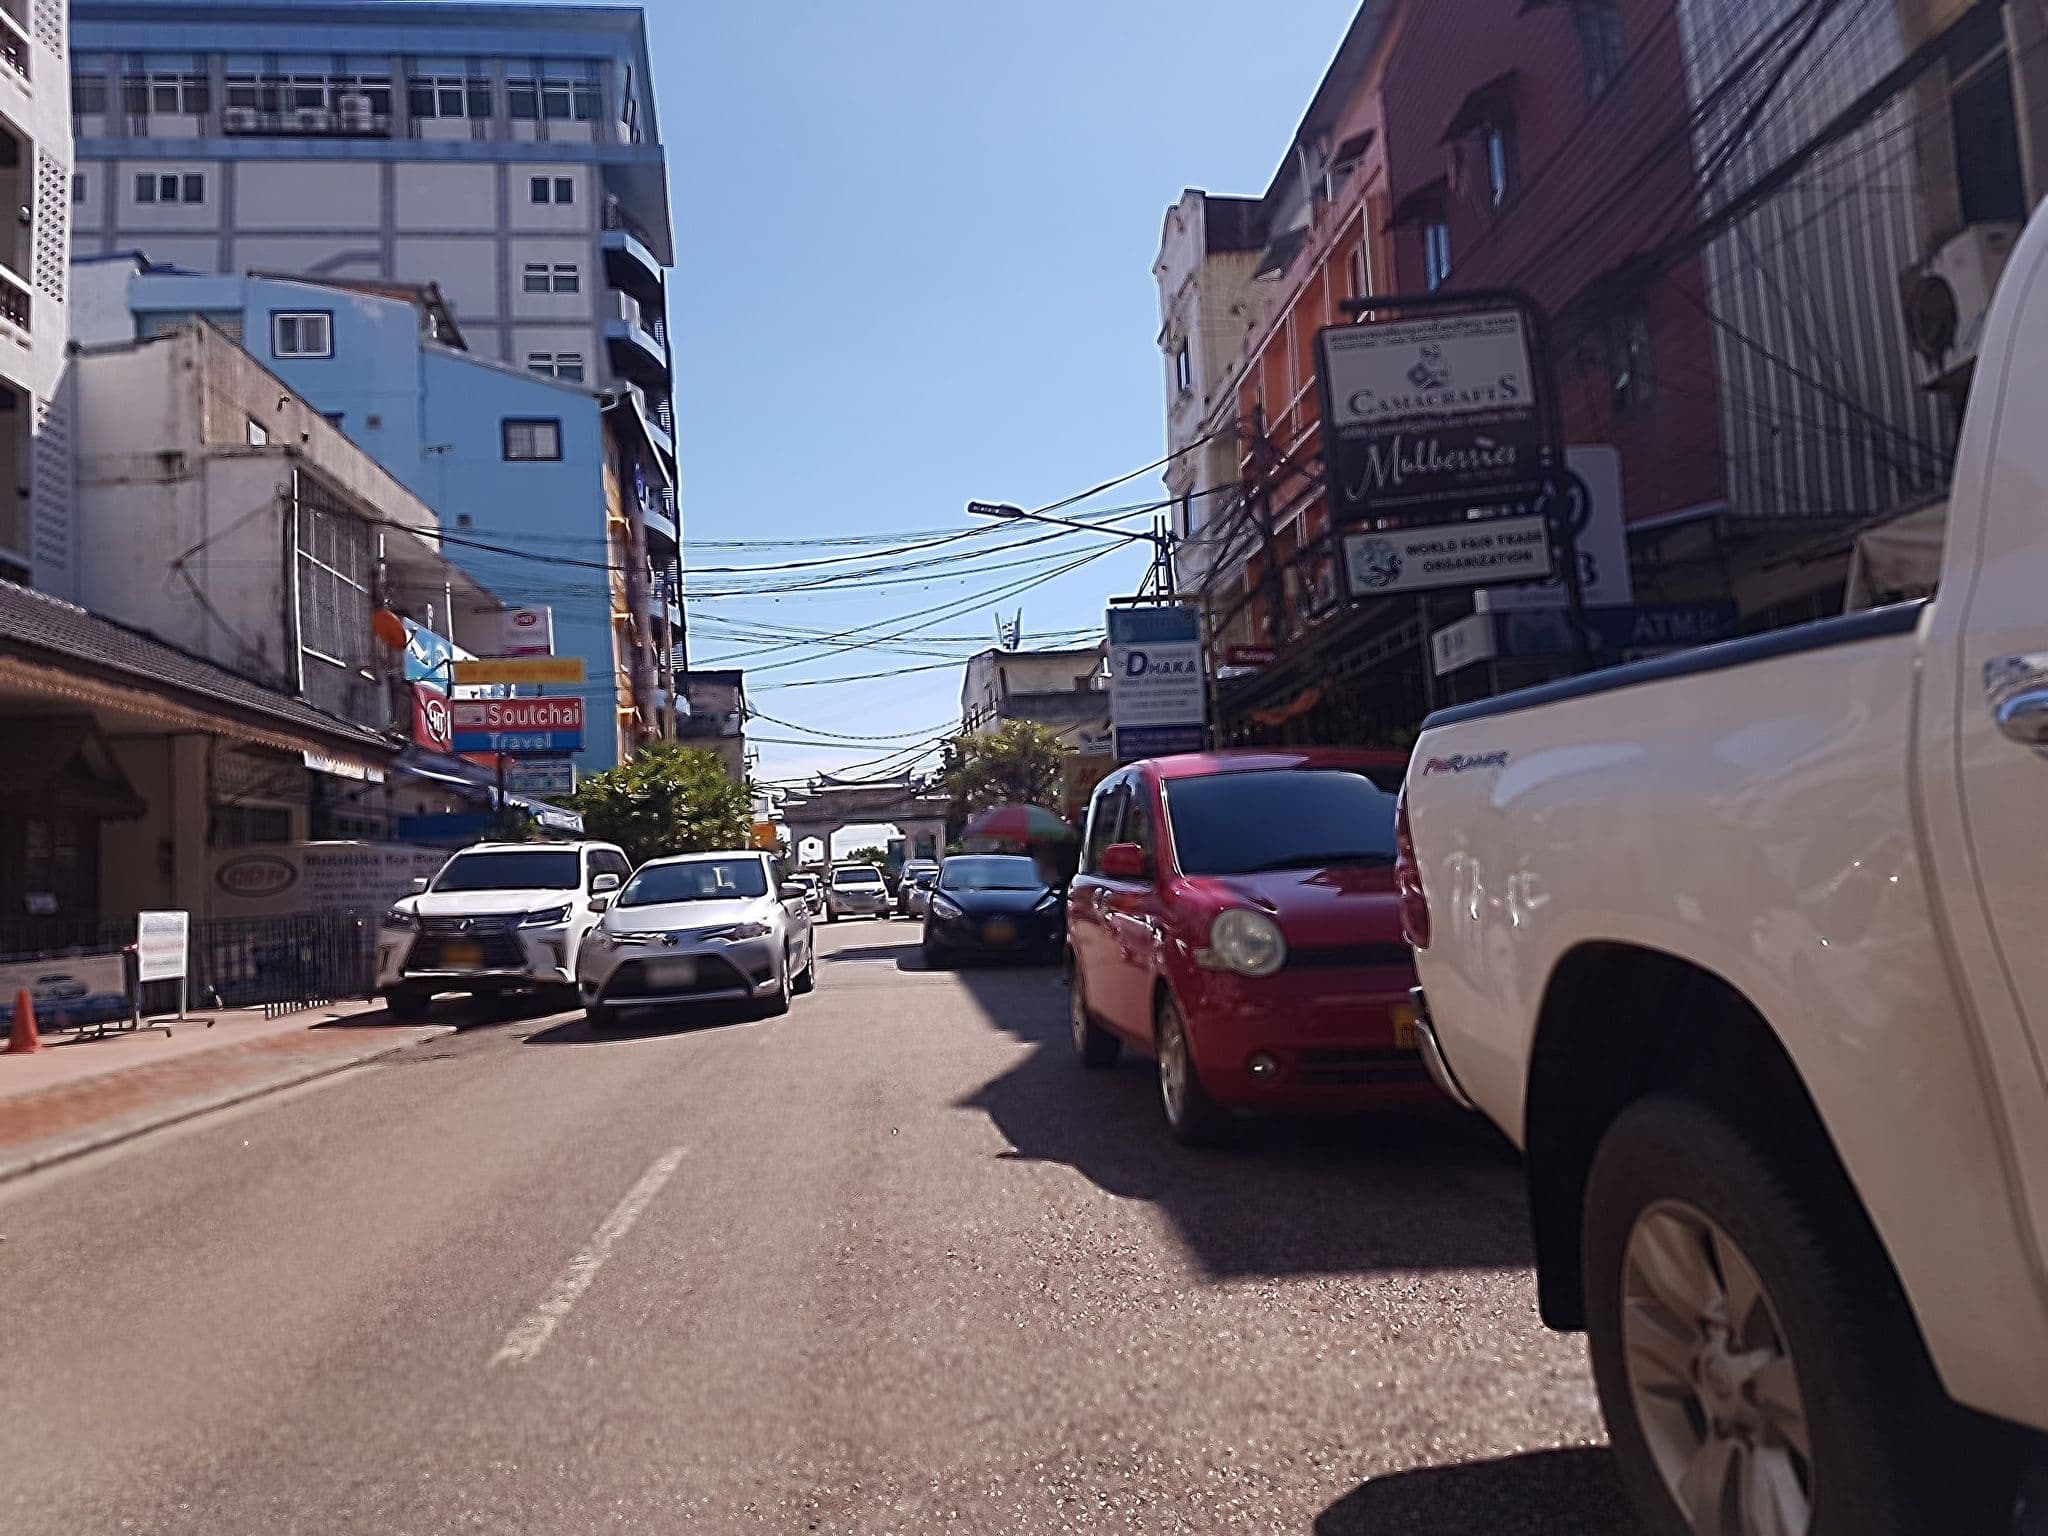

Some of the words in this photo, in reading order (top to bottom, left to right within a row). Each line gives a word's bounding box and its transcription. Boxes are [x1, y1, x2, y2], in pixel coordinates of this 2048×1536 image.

[1406, 540, 1458, 556] WORLD
[1461, 536, 1493, 549] FAIR
[1497, 529, 1543, 545] TRADE
[1423, 551, 1533, 573] ORGANIZATION
[487, 701, 580, 726] Soutchai
[488, 732, 552, 750] Travel
